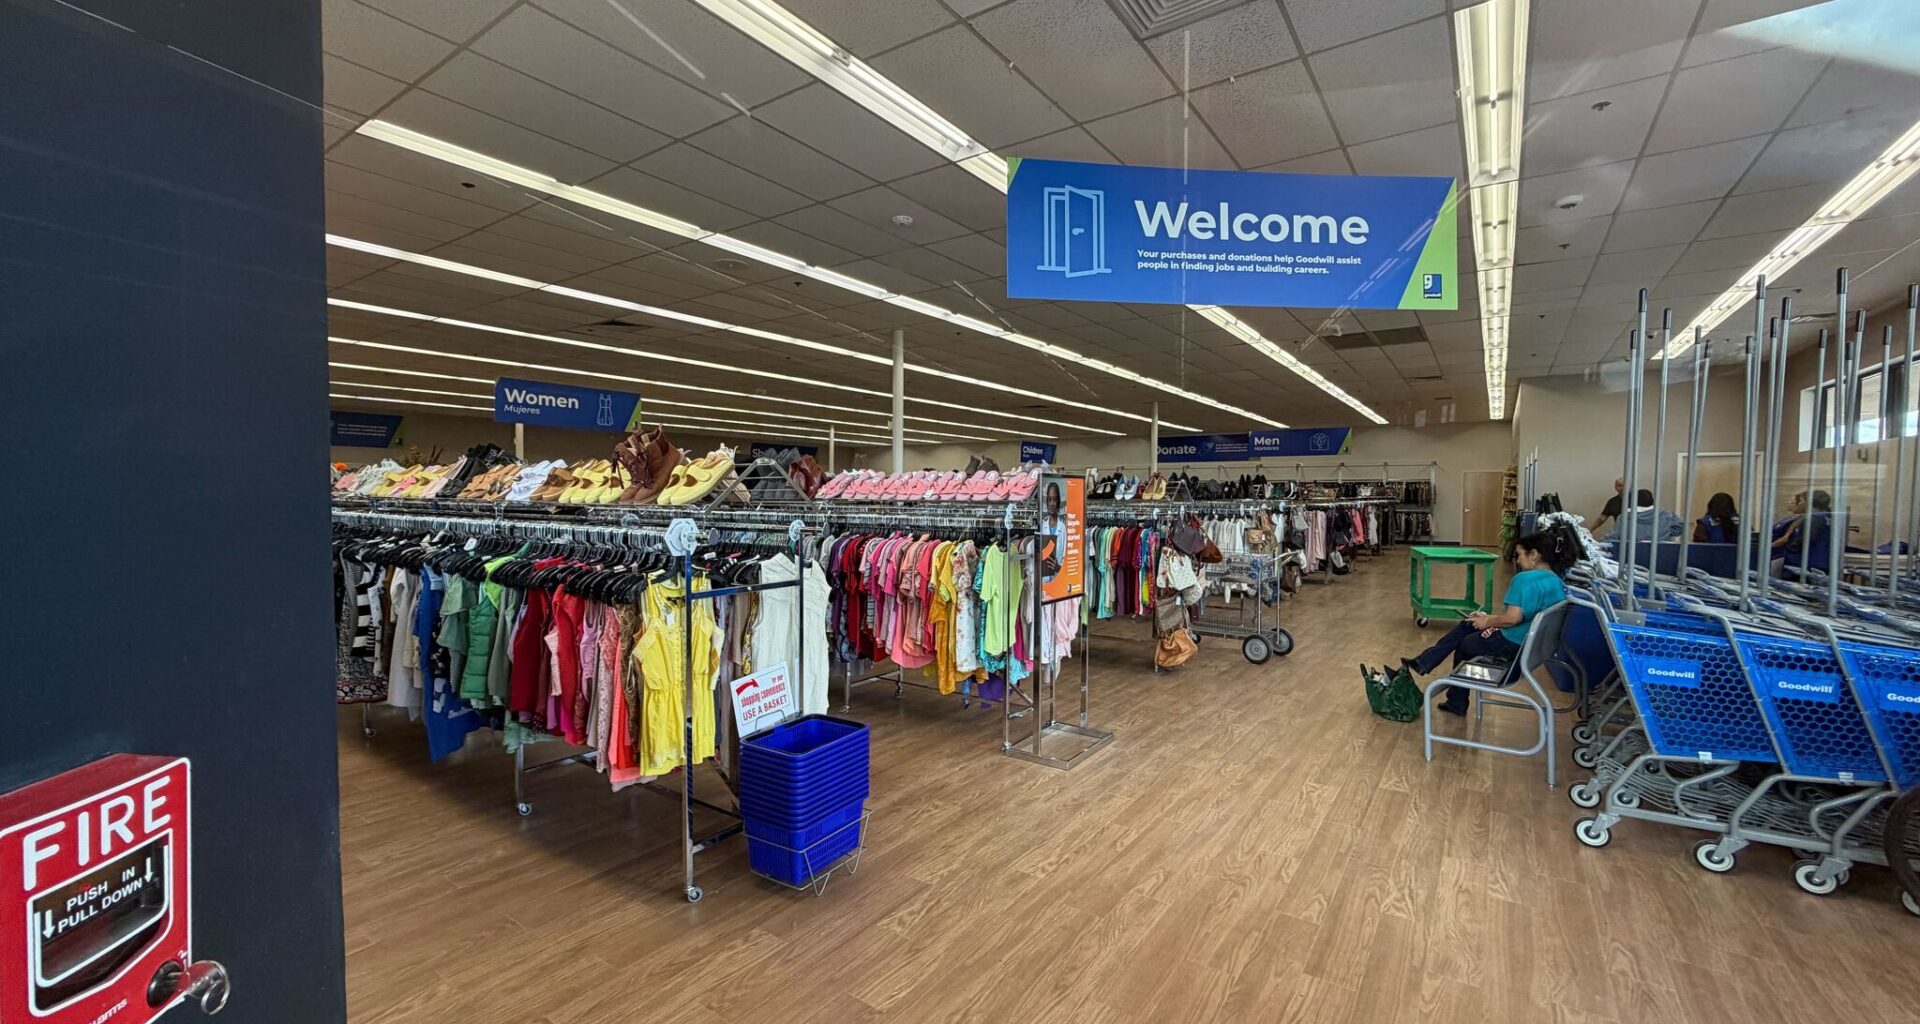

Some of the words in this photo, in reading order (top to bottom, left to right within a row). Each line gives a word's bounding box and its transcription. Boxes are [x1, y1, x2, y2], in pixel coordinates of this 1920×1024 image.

[1134, 200, 1369, 244] Welcome
[1137, 250, 1159, 258] Your
[1161, 251, 1207, 260] purchases
[1209, 253, 1226, 261] and
[1227, 253, 1272, 262] donations
[1274, 254, 1293, 265] help
[1295, 255, 1335, 264] Goodwill
[1336, 256, 1361, 265] assist
[1137, 260, 1168, 271] people
[1170, 261, 1179, 269] in
[1181, 261, 1214, 272] finding
[1215, 262, 1235, 273] jobs
[1237, 263, 1254, 272] and
[1255, 264, 1292, 275] building
[1294, 266, 1330, 274] careers.
[504, 387, 580, 410] Women
[503, 404, 541, 415] Mujeres
[1254, 436, 1280, 446] Men
[1647, 667, 1695, 679] Goodwill
[1778, 680, 1833, 694] Goodwill
[742, 707, 757, 721] USE
[758, 705, 763, 714] A
[763, 694, 787, 712] BASKET
[23, 775, 171, 891] FIRE
[66, 880, 108, 912] PUSH
[121, 866, 136, 883] IN
[57, 908, 98, 934] PULL
[101, 876, 143, 909] DOWN
